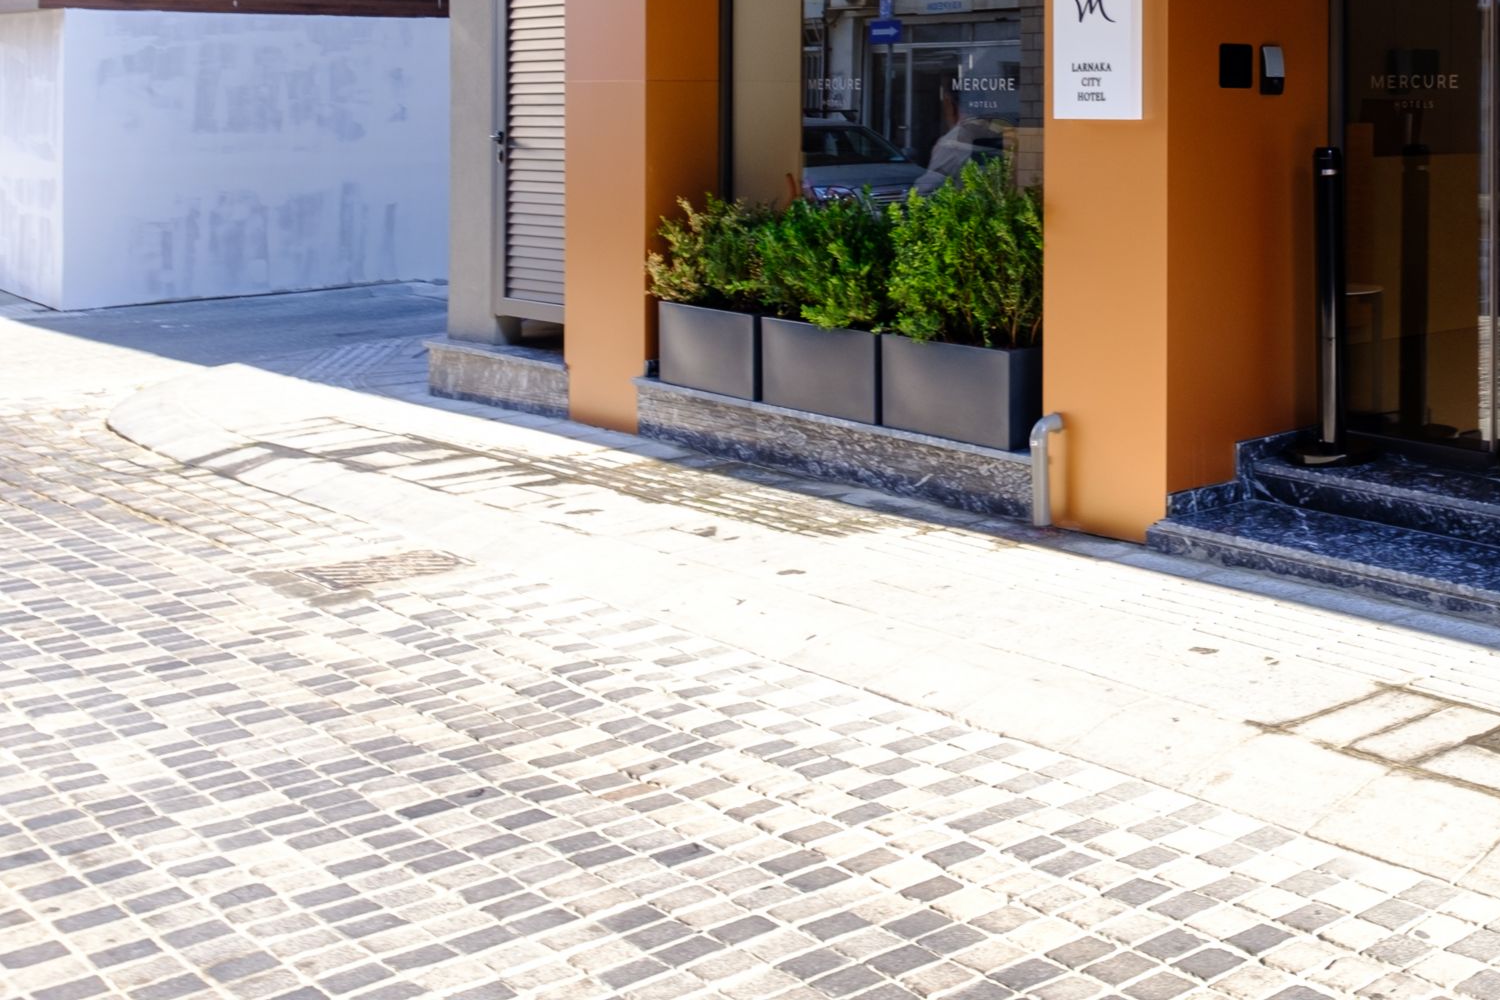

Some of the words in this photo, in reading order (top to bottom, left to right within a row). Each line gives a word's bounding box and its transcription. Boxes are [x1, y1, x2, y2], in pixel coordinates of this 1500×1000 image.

[1072, 63, 1112, 72] LARNAKA
[808, 78, 862, 91] MERCURE
[952, 78, 1015, 91] MERCURE
[1081, 77, 1102, 87] CITY
[1371, 74, 1459, 89] MERCURE
[1077, 92, 1106, 101] HOTEL
